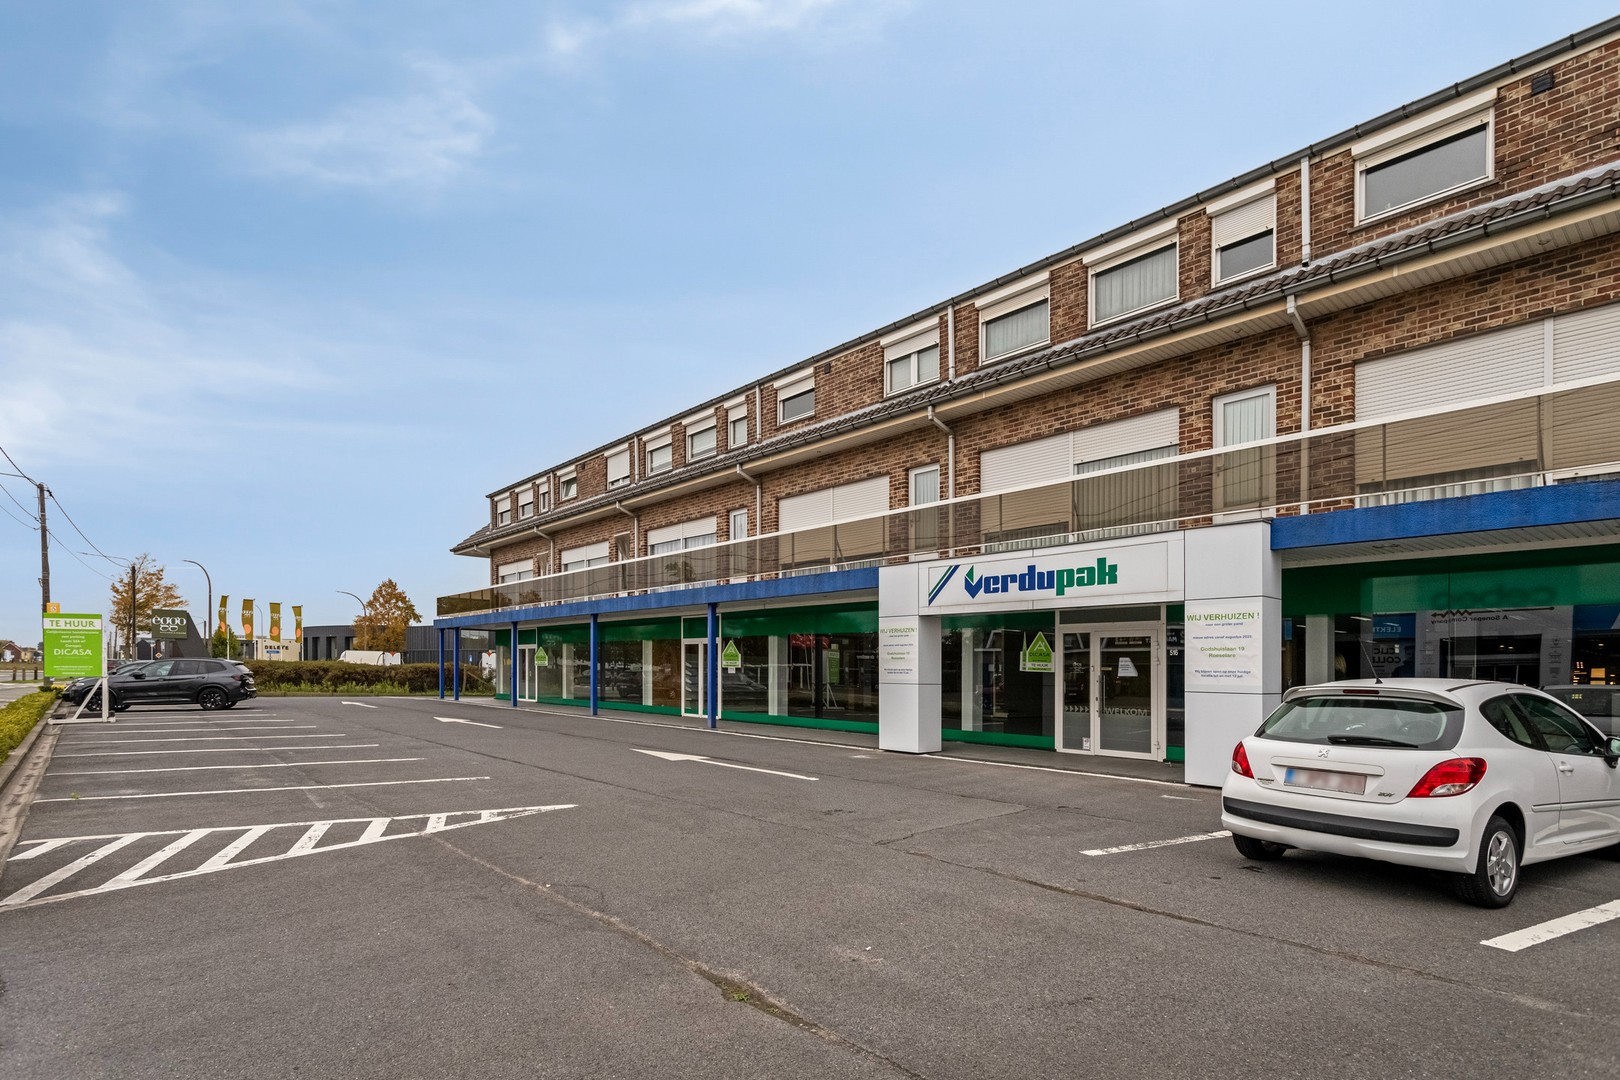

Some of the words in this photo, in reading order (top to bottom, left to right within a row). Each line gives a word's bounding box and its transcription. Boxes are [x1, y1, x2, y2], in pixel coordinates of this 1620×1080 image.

[964, 557, 1118, 599] Verdupak
[1203, 612, 1255, 621] VERHUIZEN
[53, 648, 92, 656] DICASA
[1104, 707, 1148, 716] WELKOM
